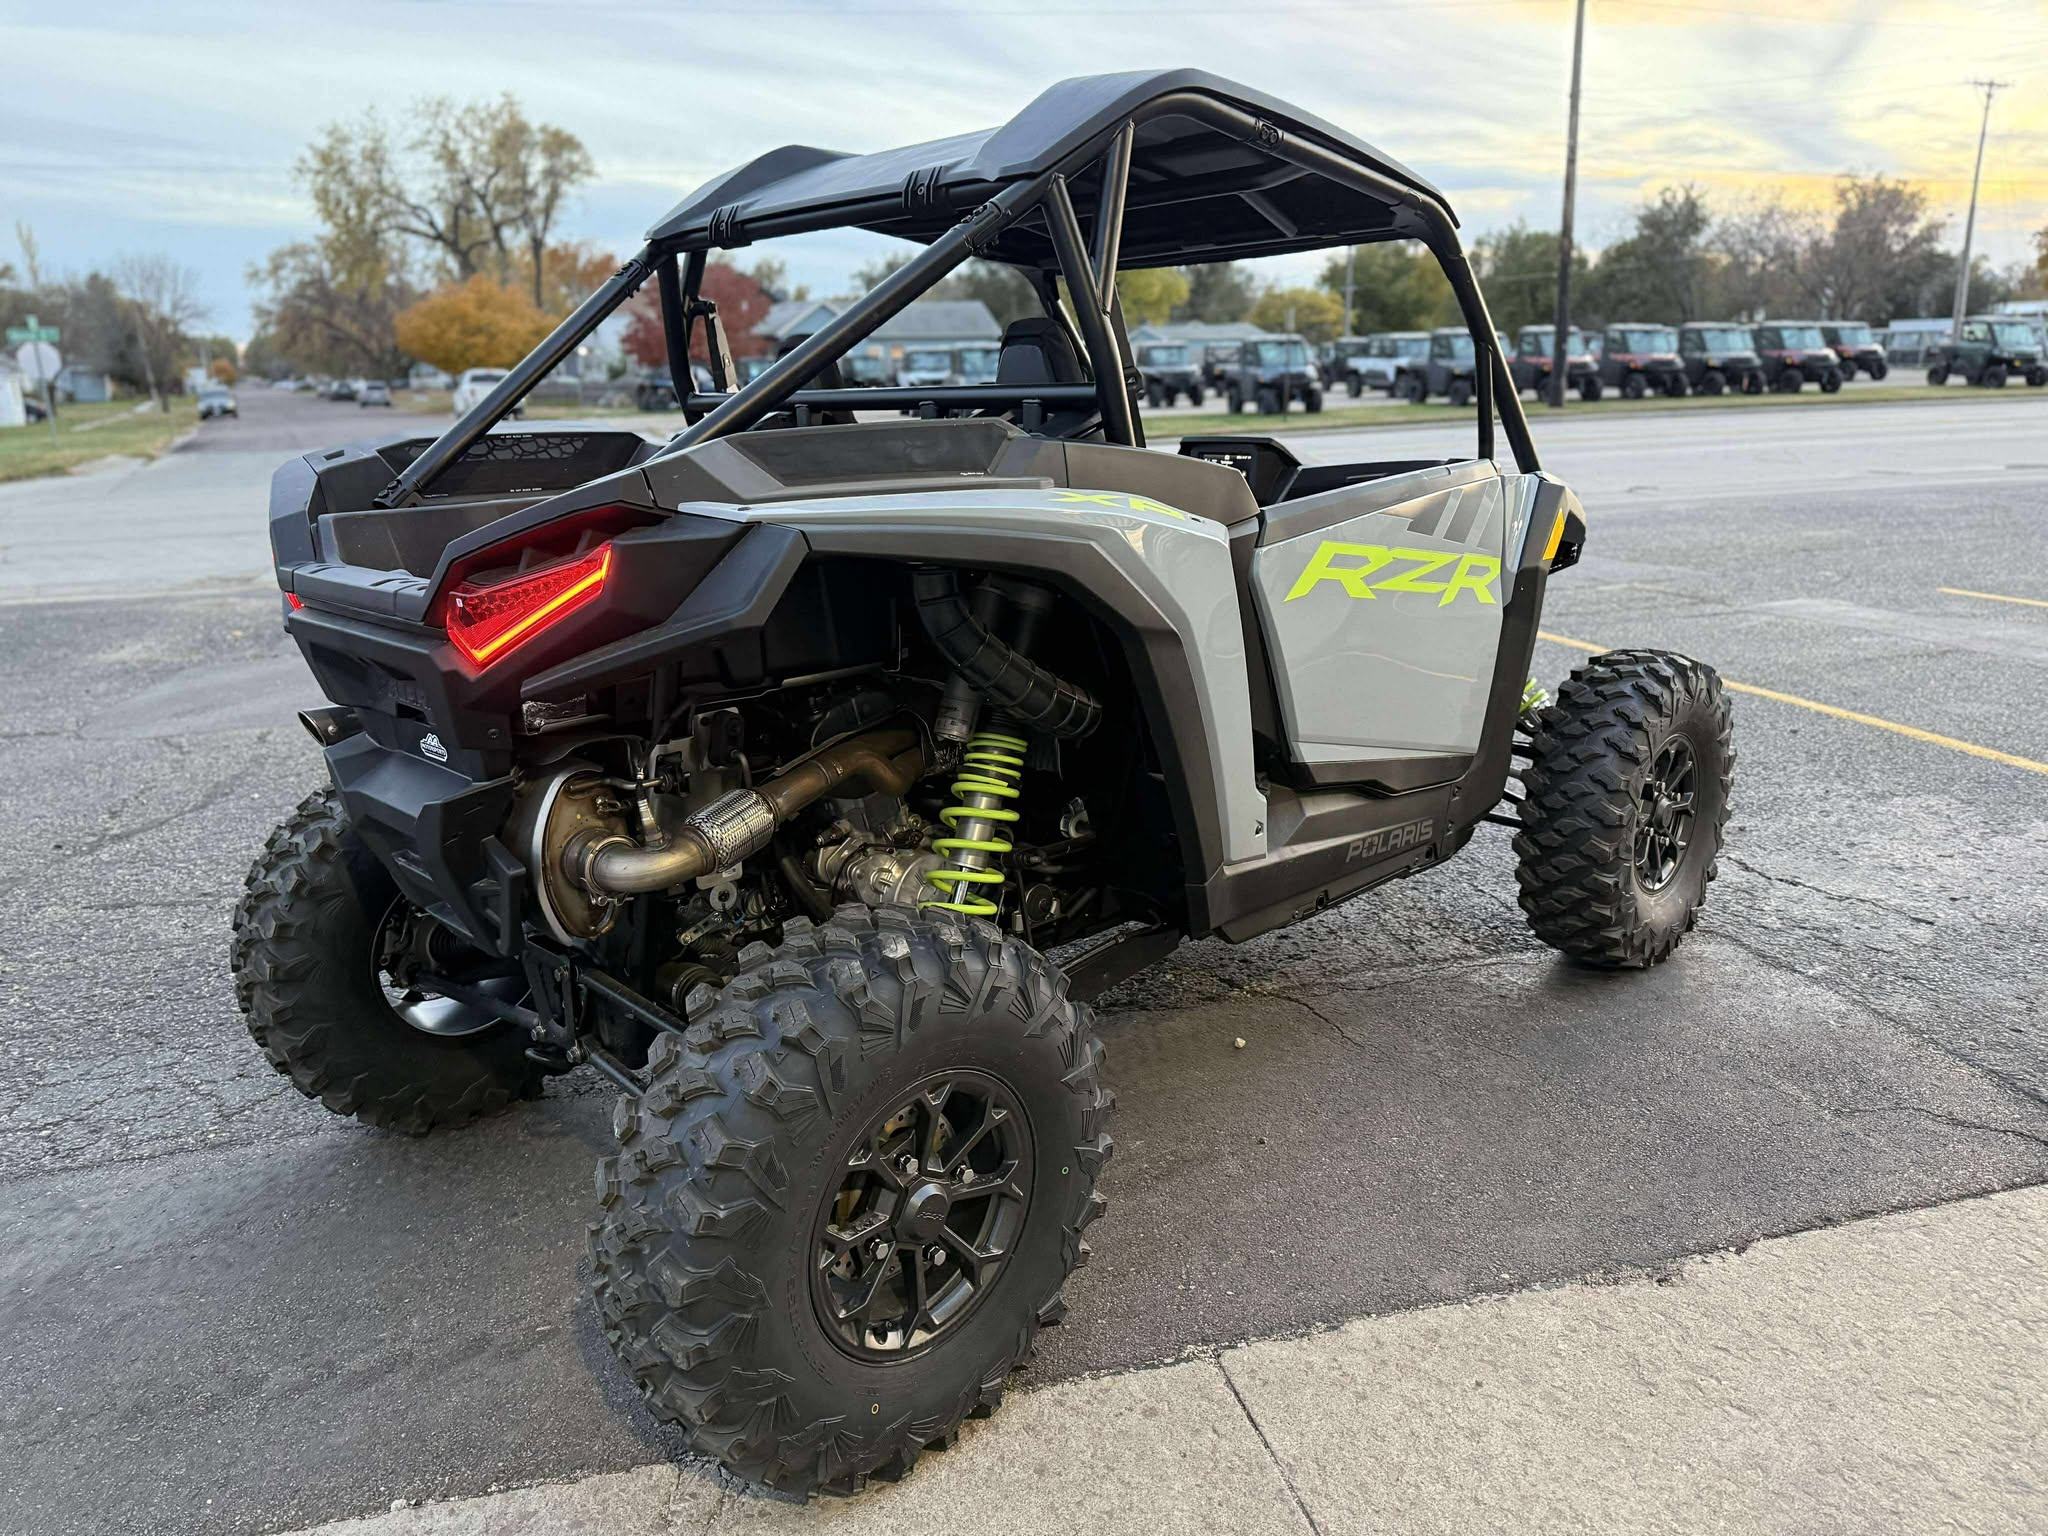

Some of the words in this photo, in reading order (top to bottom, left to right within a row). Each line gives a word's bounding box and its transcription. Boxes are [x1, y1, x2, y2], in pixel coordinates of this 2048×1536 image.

[1047, 491, 1186, 521] XP
[1284, 540, 1500, 608] RZR
[1345, 819, 1433, 863] POLARIS
